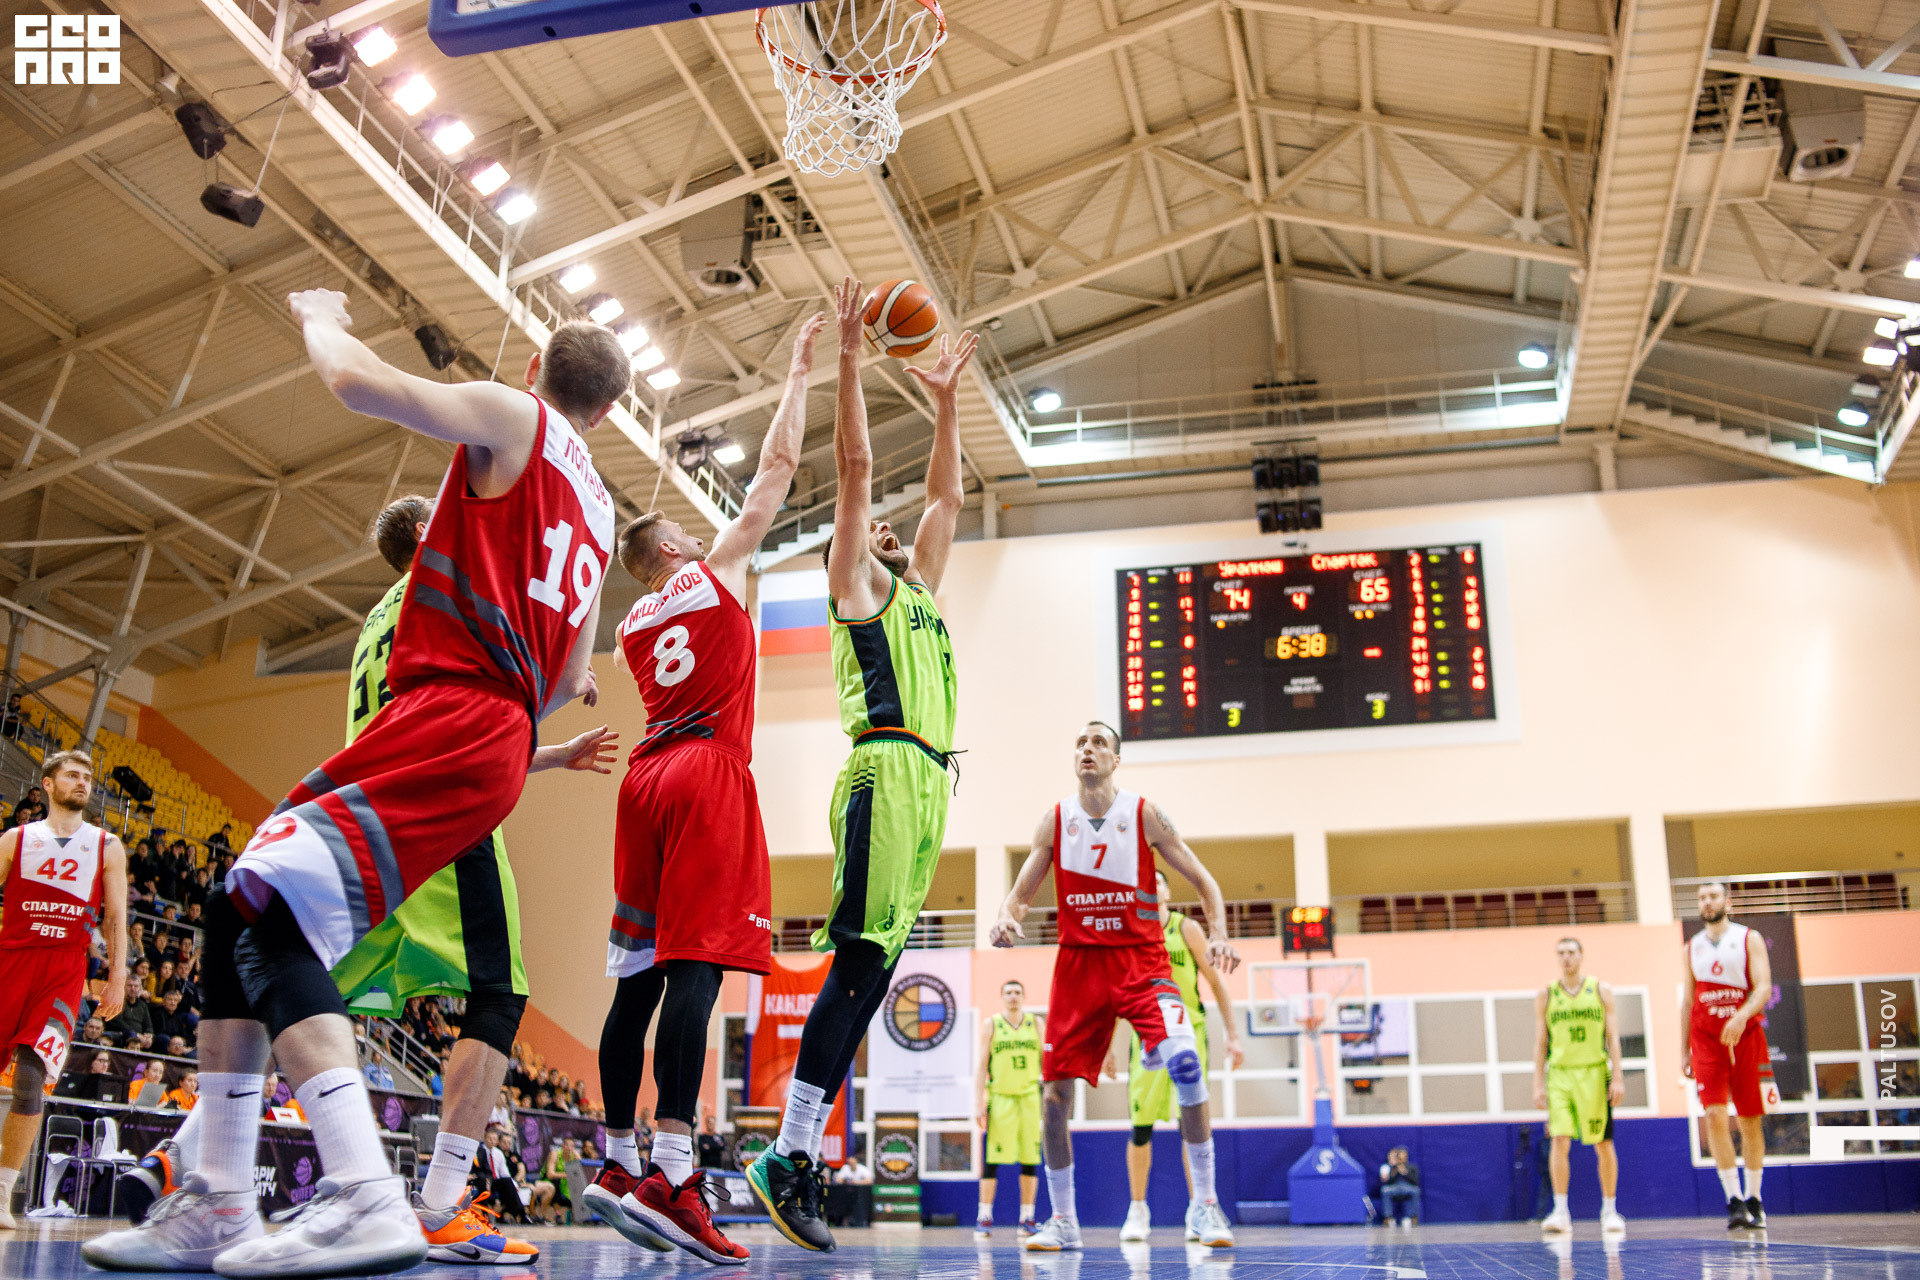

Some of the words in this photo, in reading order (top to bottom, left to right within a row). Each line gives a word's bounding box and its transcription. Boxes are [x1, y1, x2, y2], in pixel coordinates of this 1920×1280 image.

[1311, 552, 1378, 571] Спартак
[528, 519, 602, 628] 19
[1178, 571, 1192, 584] 11
[1223, 588, 1251, 610] 74
[1360, 577, 1390, 603] 65
[1292, 592, 1307, 610] 4
[1276, 632, 1327, 659] 6:38
[653, 624, 696, 688] 8
[1228, 708, 1241, 728] 3
[1372, 698, 1386, 719] 3
[1091, 843, 1108, 870] 7
[36, 857, 79, 882] 42
[21, 900, 86, 916] СПАРТАК
[1066, 891, 1135, 906] СПАРТАК
[39, 924, 67, 939] ВТБ
[755, 916, 771, 930] ВТБ
[1095, 917, 1122, 932] ВТБ
[1711, 960, 1723, 976] 6
[1170, 1003, 1185, 1025] 7
[1569, 1025, 1586, 1043] 10
[36, 1035, 65, 1067] 42
[1011, 1055, 1027, 1070] 13
[253, 1166, 277, 1182] АРИ
